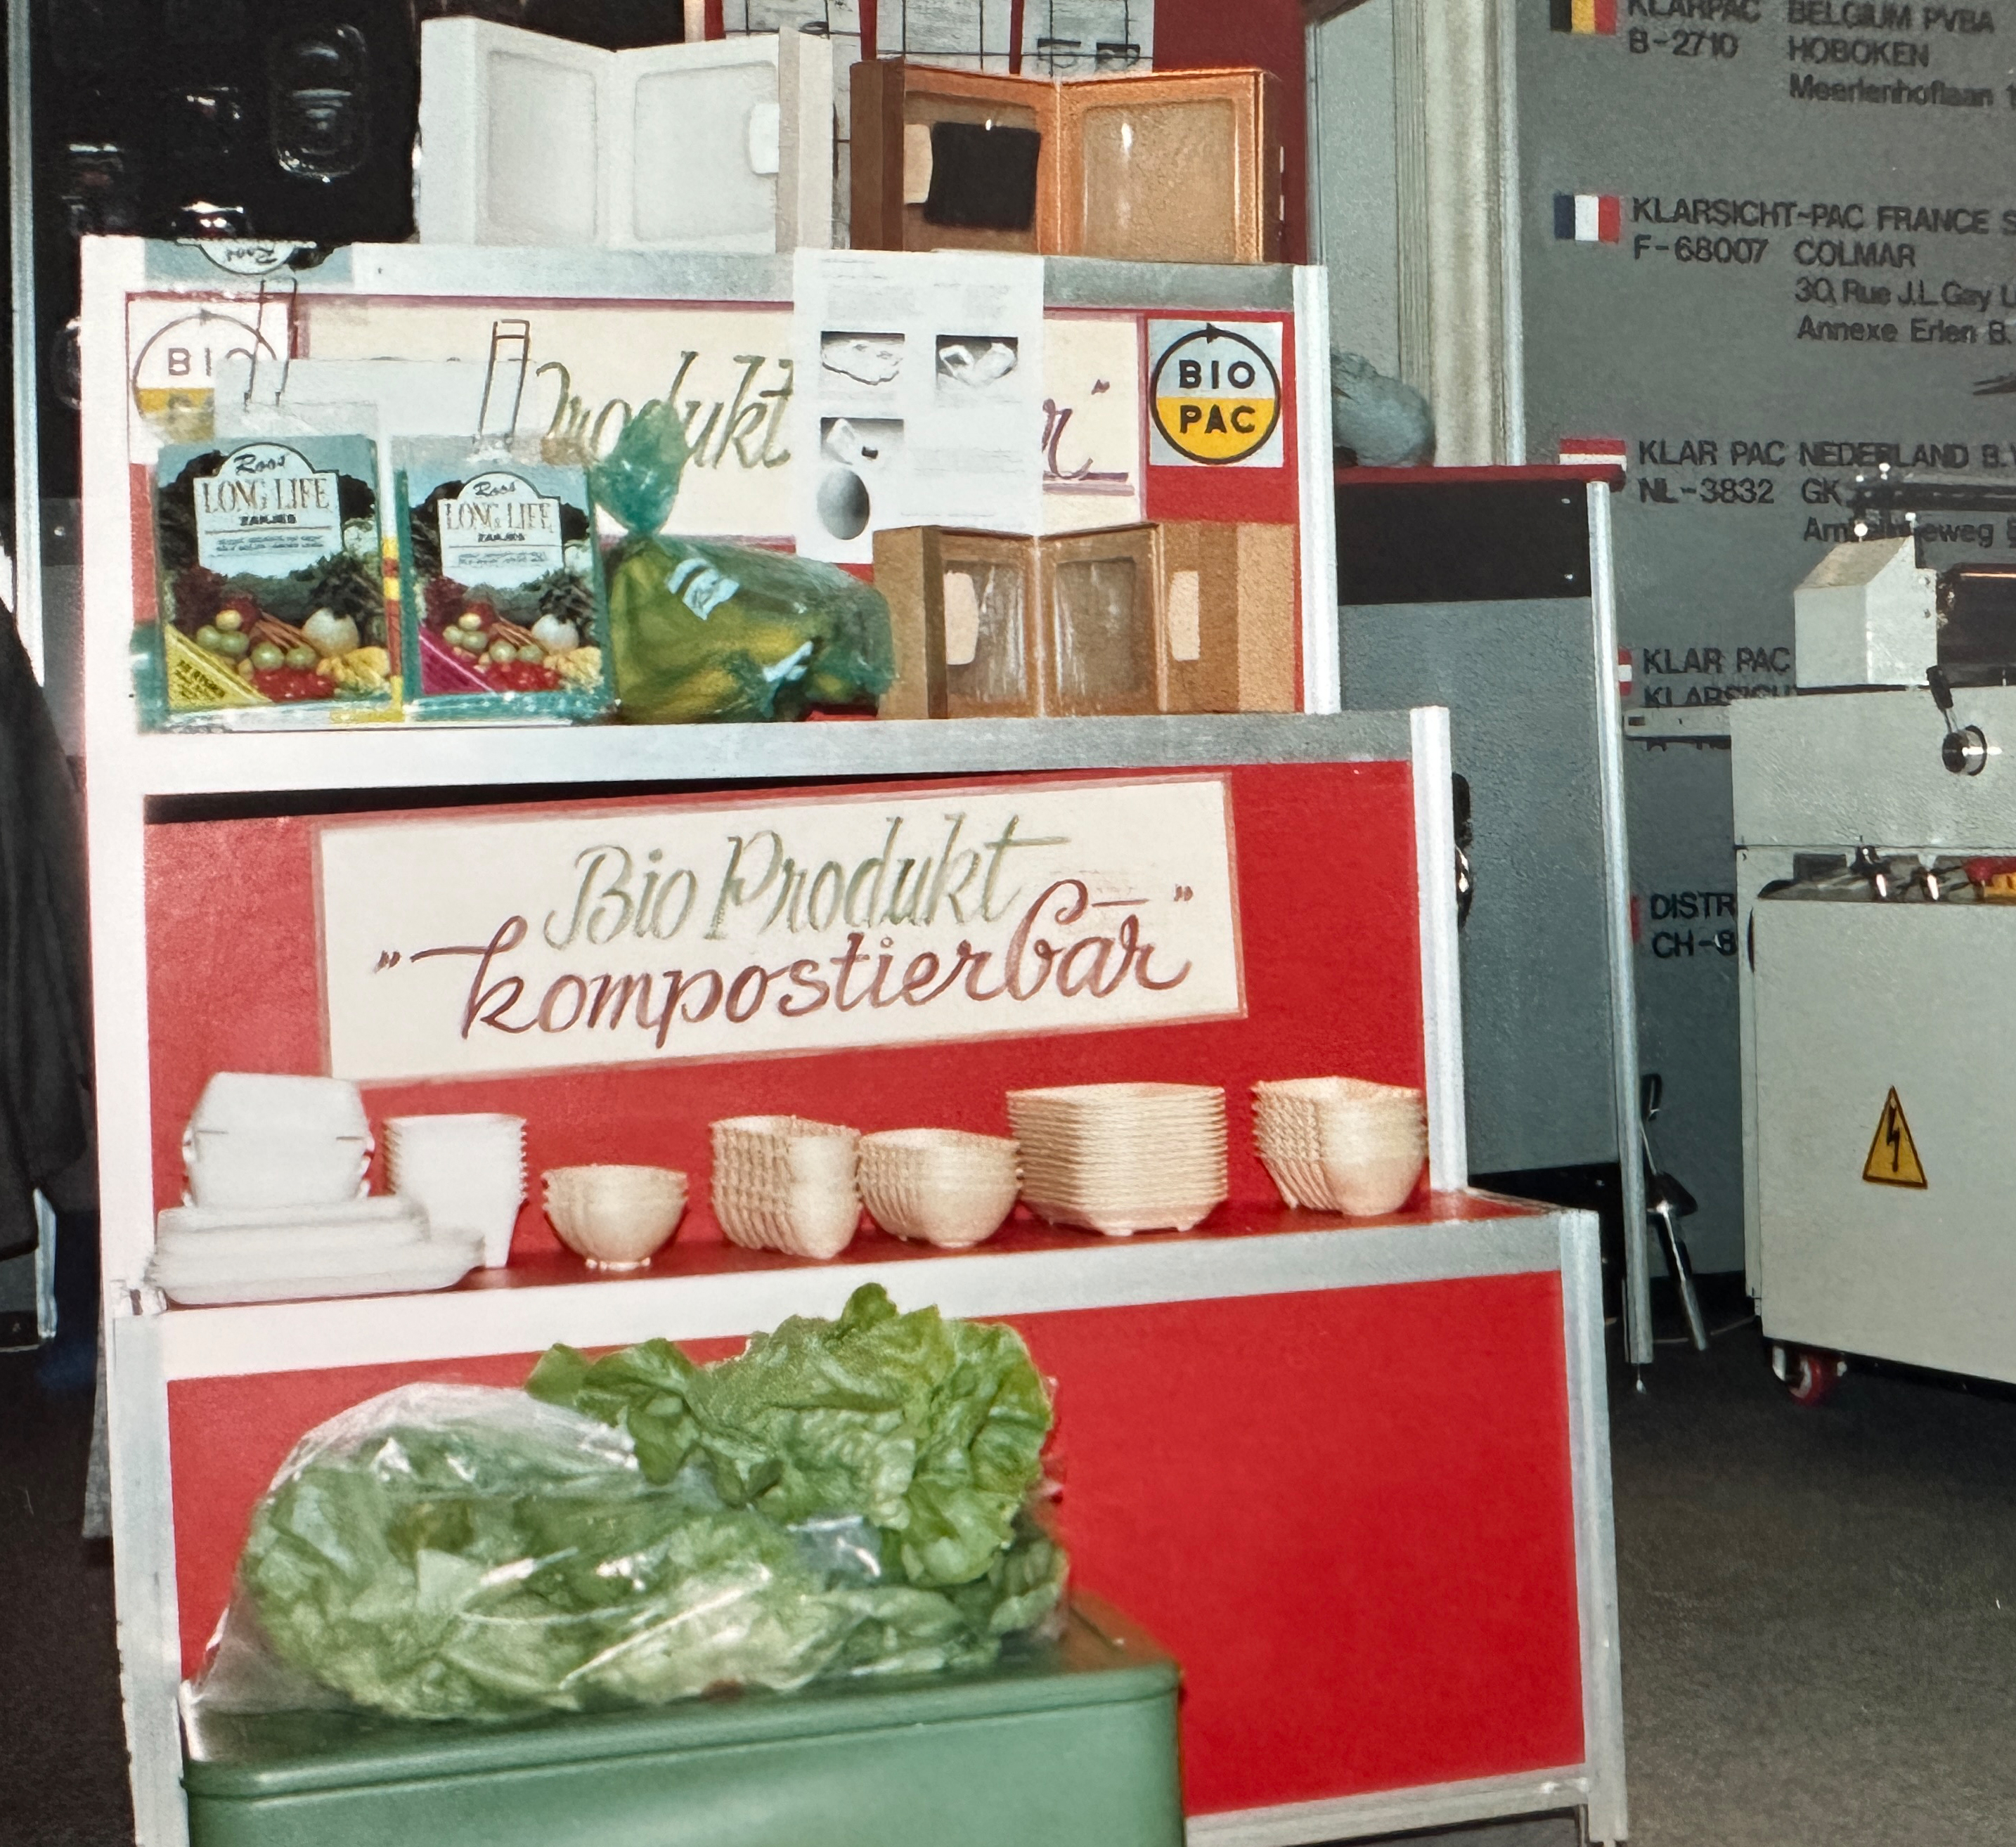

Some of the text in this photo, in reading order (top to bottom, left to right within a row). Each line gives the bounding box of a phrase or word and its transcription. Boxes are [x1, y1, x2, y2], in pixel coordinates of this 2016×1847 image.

[1788, 0, 1911, 30] BELGIUM
[1629, 27, 1929, 67] B-2710 HOBOKEN
[1633, 197, 1864, 230] KLARSICHT-PAC
[1878, 205, 1990, 235] FRANCE
[1794, 238, 1916, 268] COLMAR
[1842, 278, 1892, 305] Rue
[1797, 315, 1899, 342] Annexe
[1178, 359, 1256, 389] BIO
[1180, 404, 1256, 434] PAC
[1639, 440, 1717, 465] KLAR
[1731, 440, 1786, 466] PAC
[1799, 442, 1969, 468] NEDERLAND
[203, 477, 331, 513] LONG LIFE
[1639, 478, 1775, 504] NL-3832
[444, 501, 554, 533] LONG LIFE
[1643, 647, 1791, 675] KLAR PAC
[543, 814, 1071, 951] Bio Produkt
